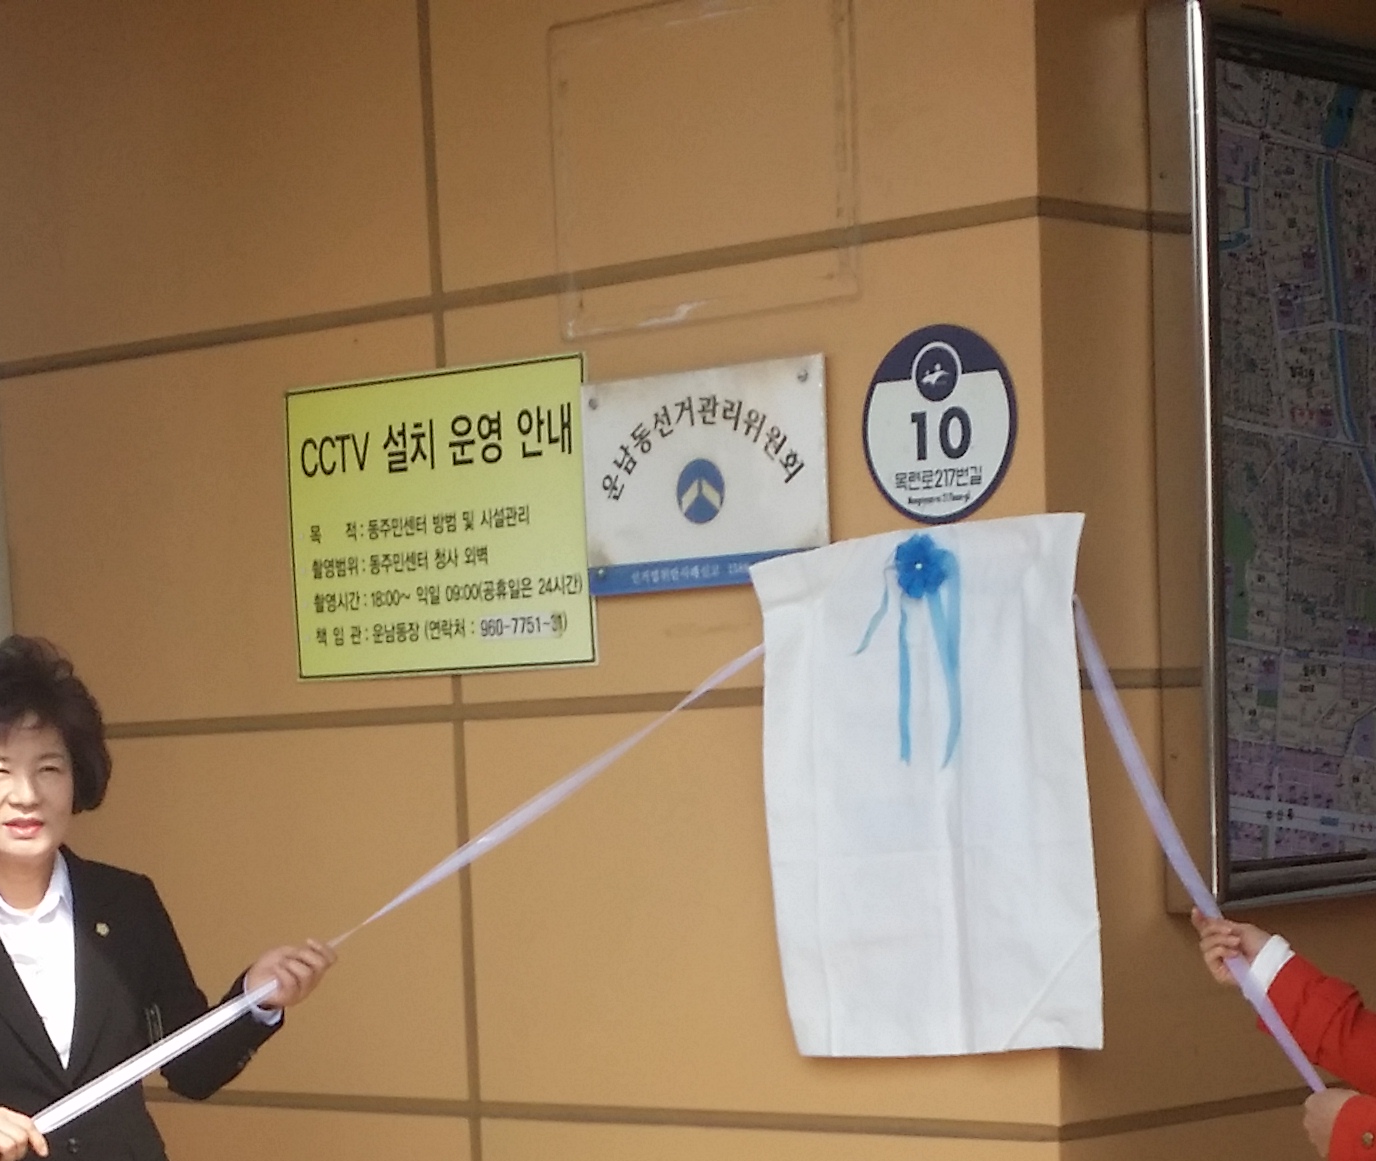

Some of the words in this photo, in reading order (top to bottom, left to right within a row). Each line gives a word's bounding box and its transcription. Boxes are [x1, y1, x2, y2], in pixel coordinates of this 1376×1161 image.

[301, 432, 370, 477] CCTV
[384, 418, 436, 474] 설치
[449, 411, 503, 467] 운영
[517, 402, 573, 459] 안내
[602, 394, 805, 501] 운남동선거관리위원회
[910, 406, 972, 461] 10
[895, 466, 983, 491] 목련로217번길
[310, 525, 322, 544] 목
[367, 514, 427, 540] 동주민센터
[433, 511, 457, 535] 방범
[463, 509, 475, 531] 및
[480, 505, 531, 530] 시설관리
[370, 548, 429, 575] 동주민센터
[434, 547, 459, 571] 청사
[465, 546, 489, 566] 외벽
[416, 585, 441, 605] 익일
[538, 572, 583, 595] 24시간)
[373, 621, 421, 645] 운남동장
